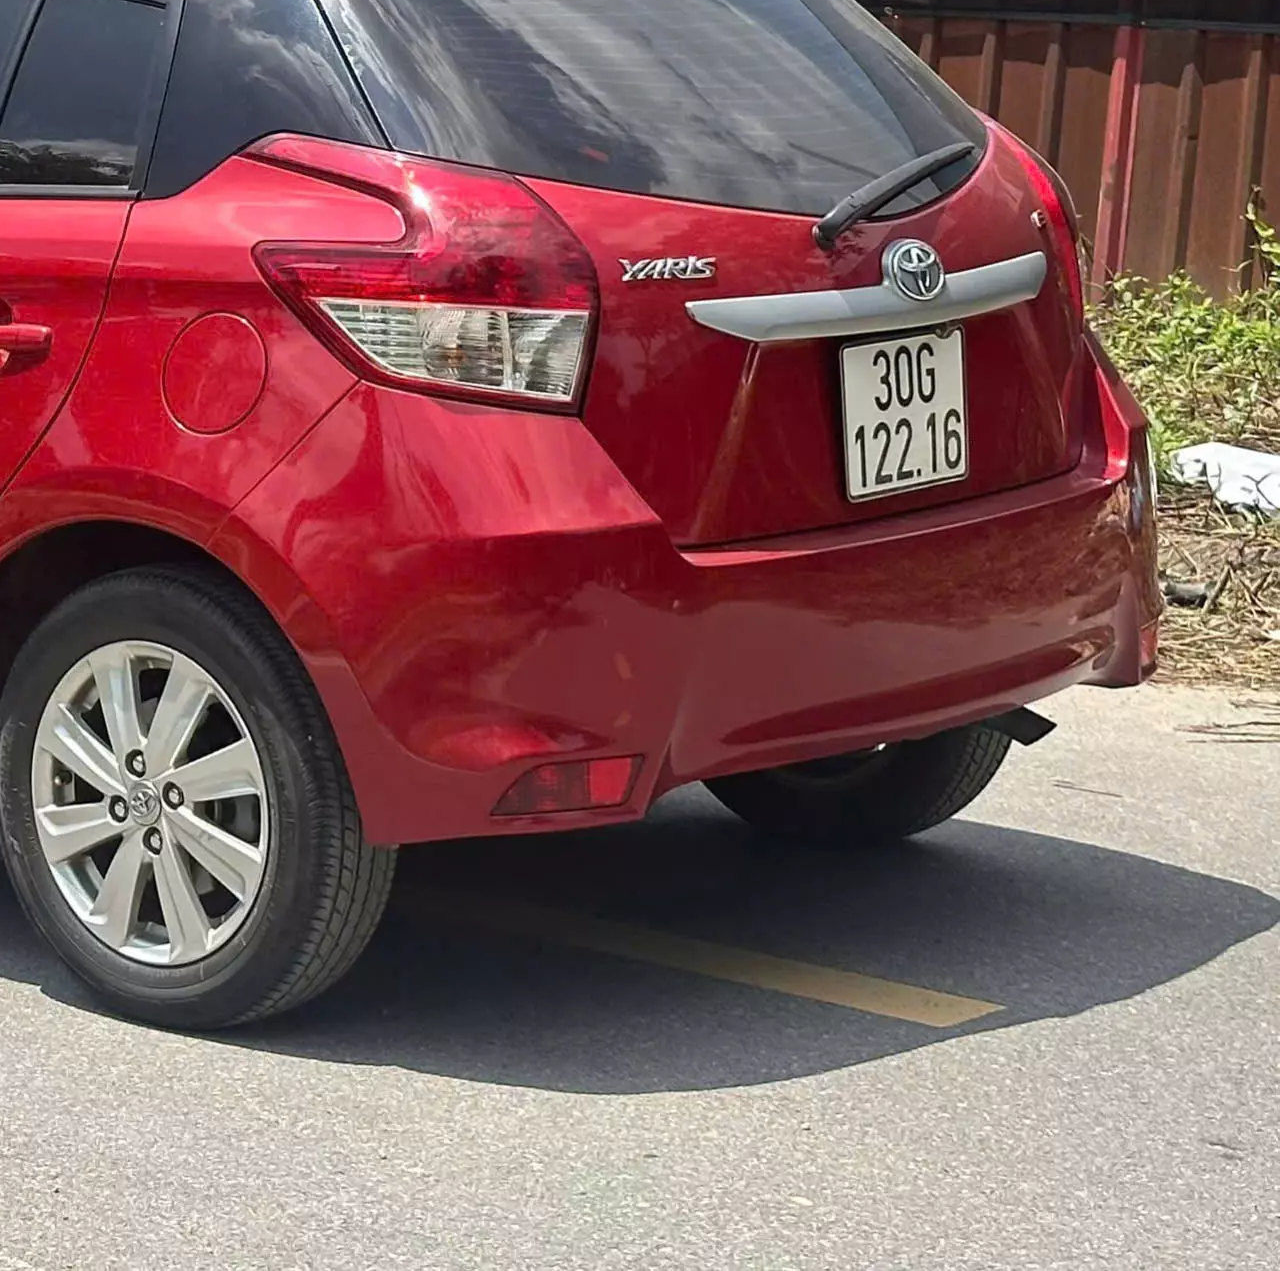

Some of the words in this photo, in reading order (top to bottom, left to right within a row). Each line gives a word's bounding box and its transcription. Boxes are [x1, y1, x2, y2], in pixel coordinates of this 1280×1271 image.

[617, 255, 717, 282] YARIS
[872, 342, 936, 411] 30G
[854, 408, 962, 488] 122.16
